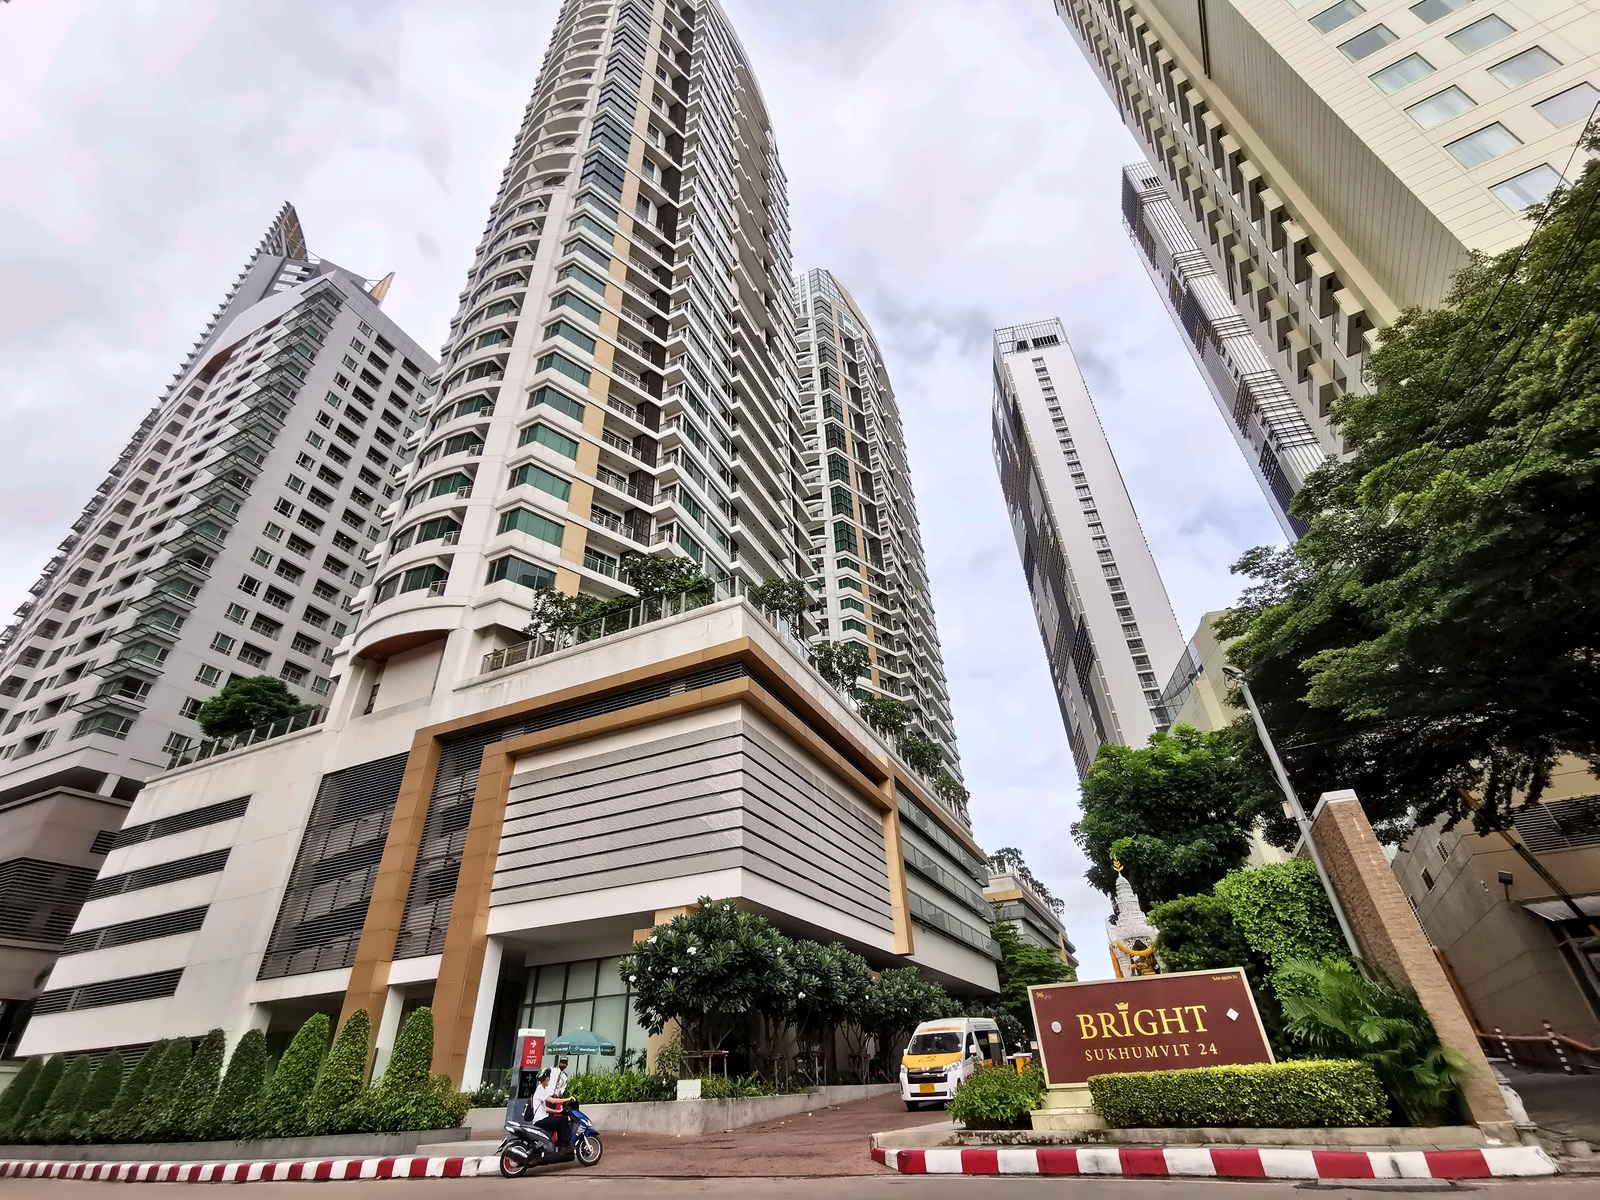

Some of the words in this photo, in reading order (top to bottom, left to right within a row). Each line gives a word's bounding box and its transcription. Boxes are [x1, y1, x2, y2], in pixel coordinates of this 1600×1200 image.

[1076, 1004, 1207, 1040] BRIGHT
[1085, 1044, 1190, 1062] SUKHUMVIT
[1198, 1042, 1218, 1055] 24
